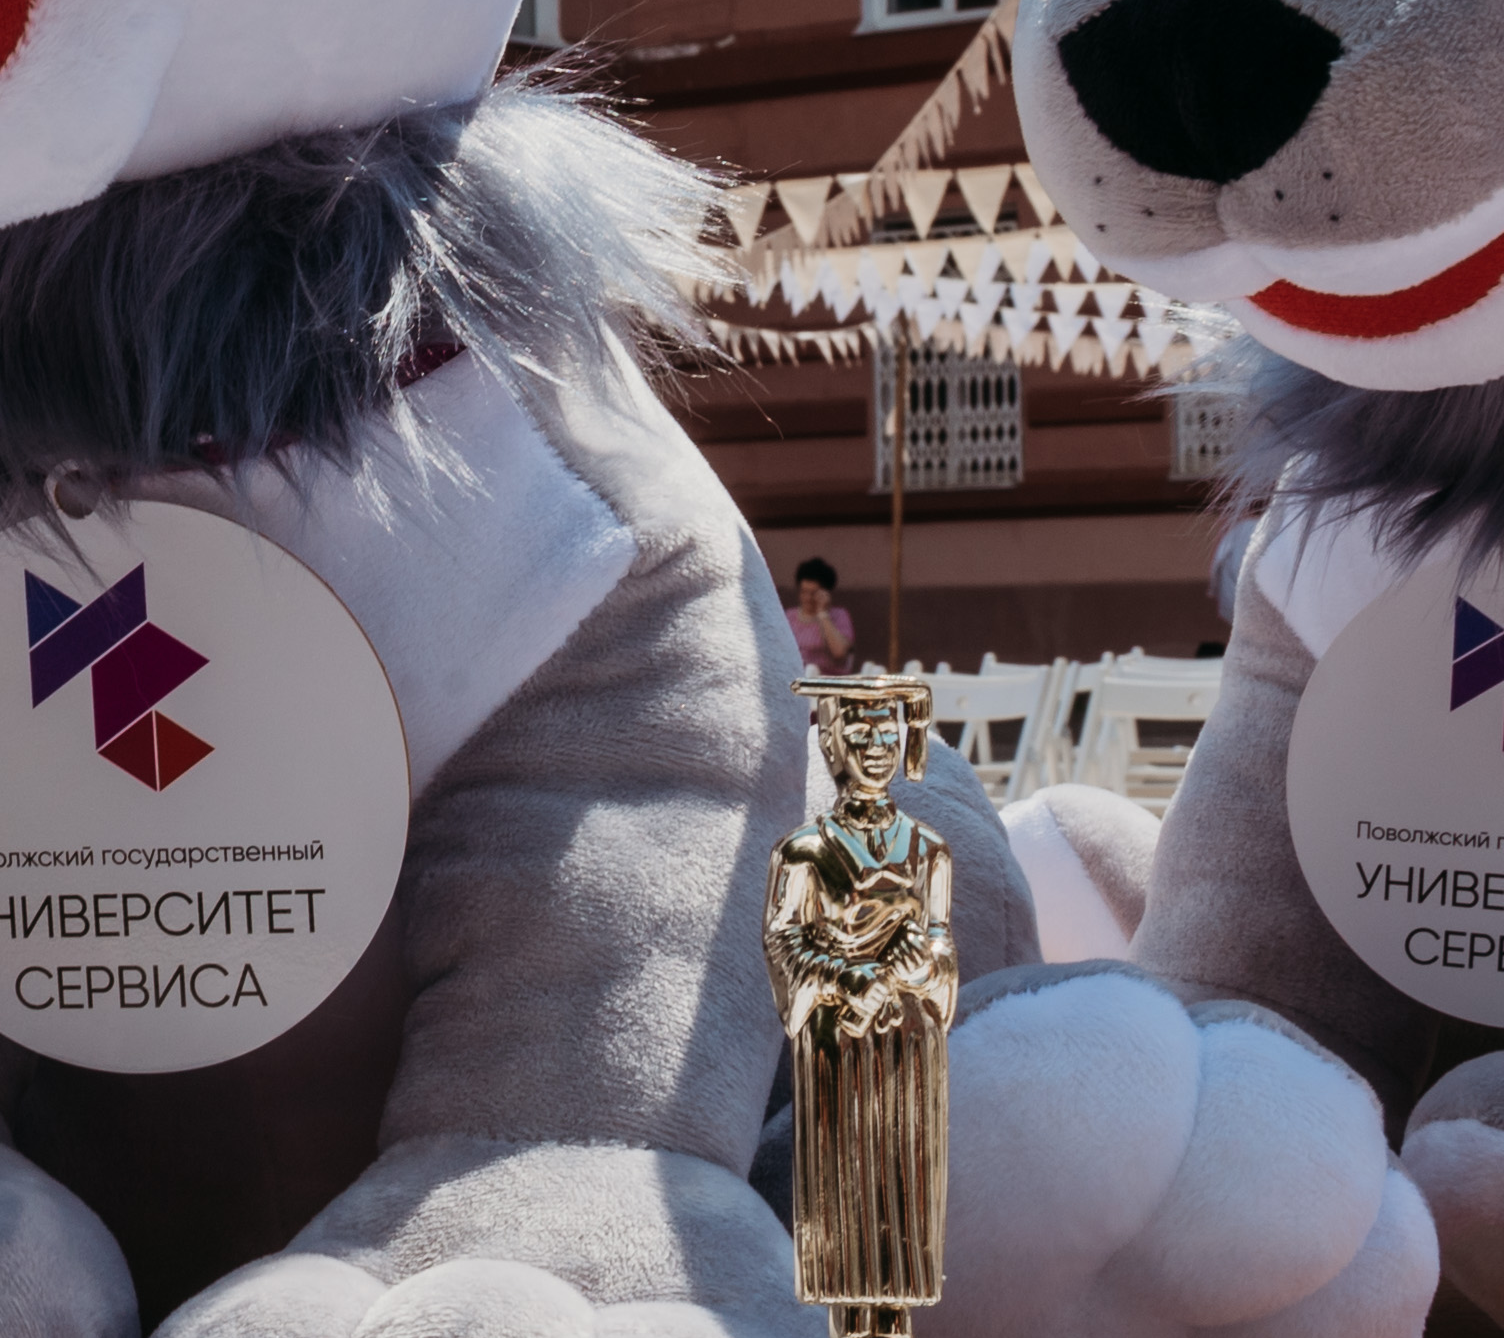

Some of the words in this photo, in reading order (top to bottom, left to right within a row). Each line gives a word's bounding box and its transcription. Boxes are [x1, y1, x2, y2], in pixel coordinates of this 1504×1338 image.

[1357, 821, 1490, 850] Поволжский
[102, 840, 324, 870] государственный
[15, 963, 268, 1010] СЕРВИСА
